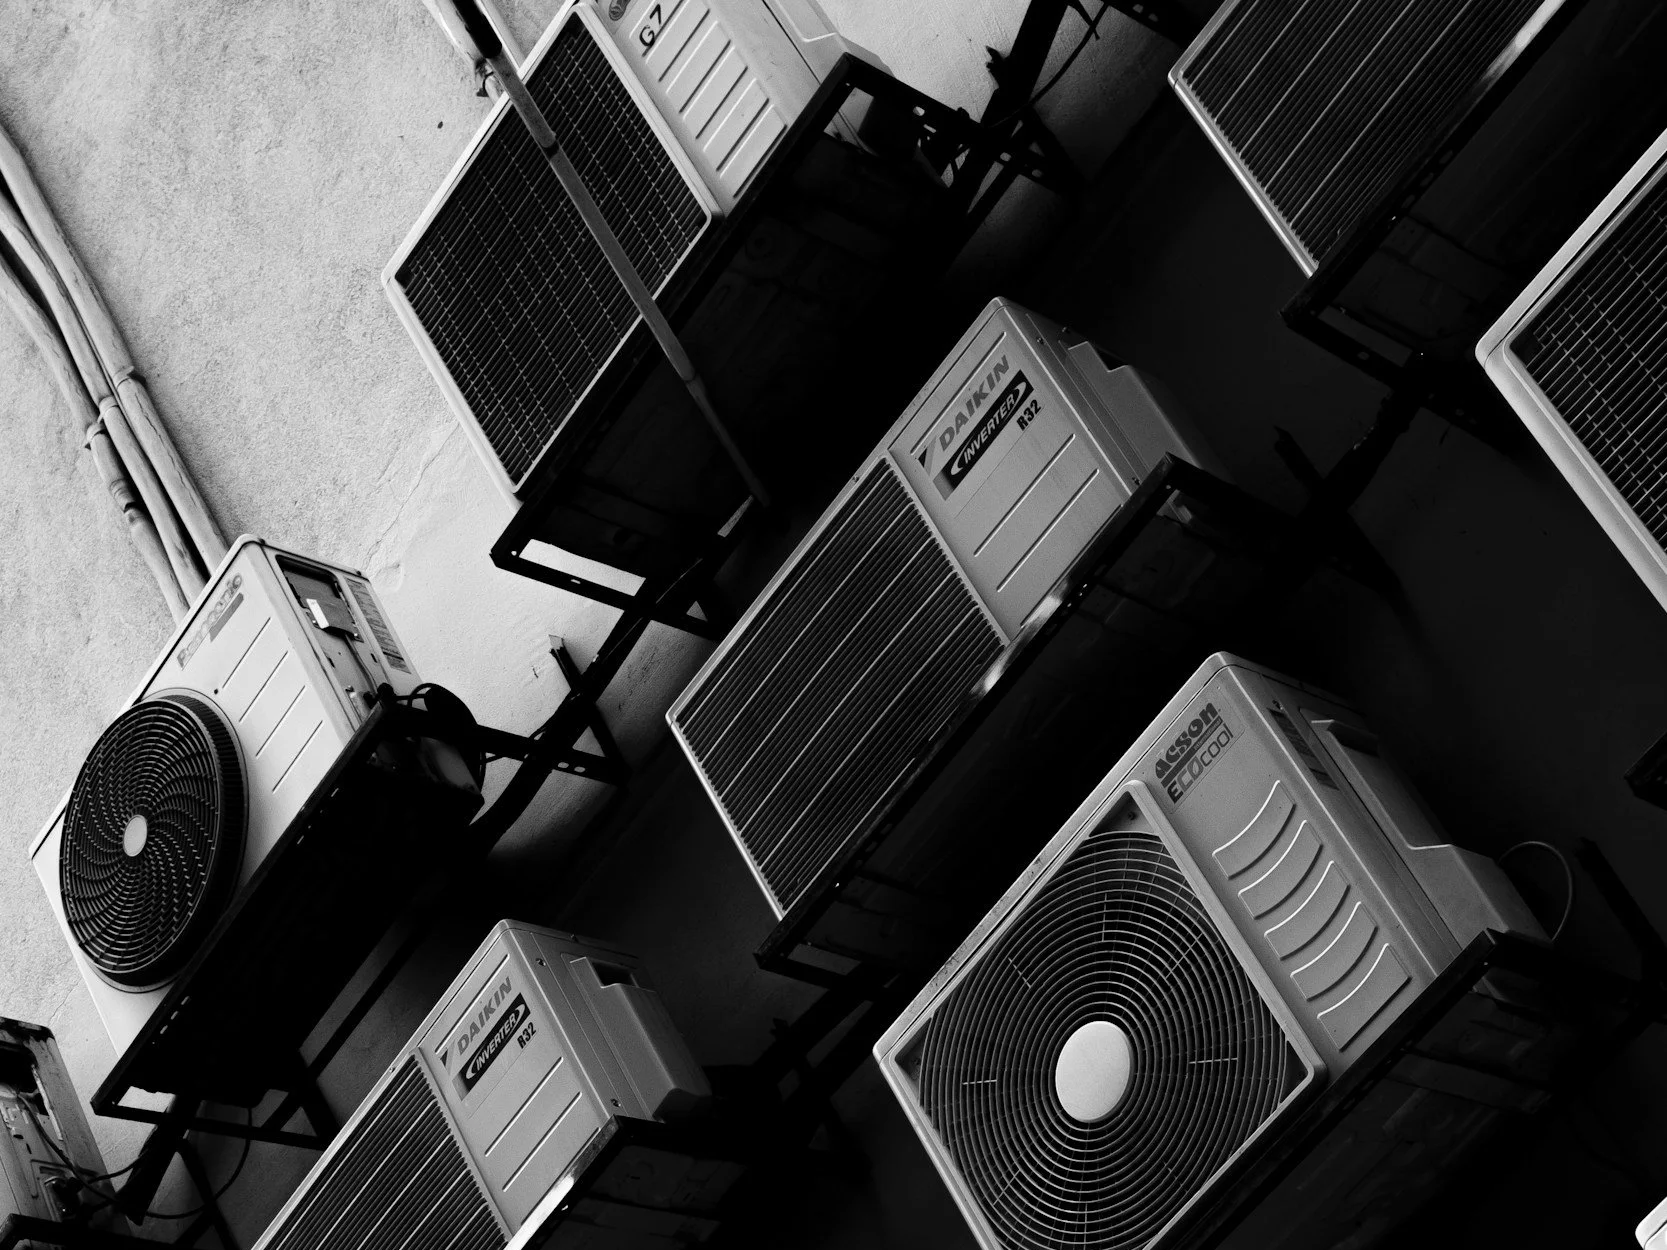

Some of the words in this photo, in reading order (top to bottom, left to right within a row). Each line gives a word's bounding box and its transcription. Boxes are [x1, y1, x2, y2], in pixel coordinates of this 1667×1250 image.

[639, 3, 662, 47] G7
[938, 354, 1010, 452] DAIKIN
[962, 393, 1015, 464] INVERTER
[1016, 399, 1042, 431] R32
[457, 976, 512, 1055] DAIKIN
[474, 1012, 517, 1071] INVERTER
[516, 1021, 537, 1049] R32
